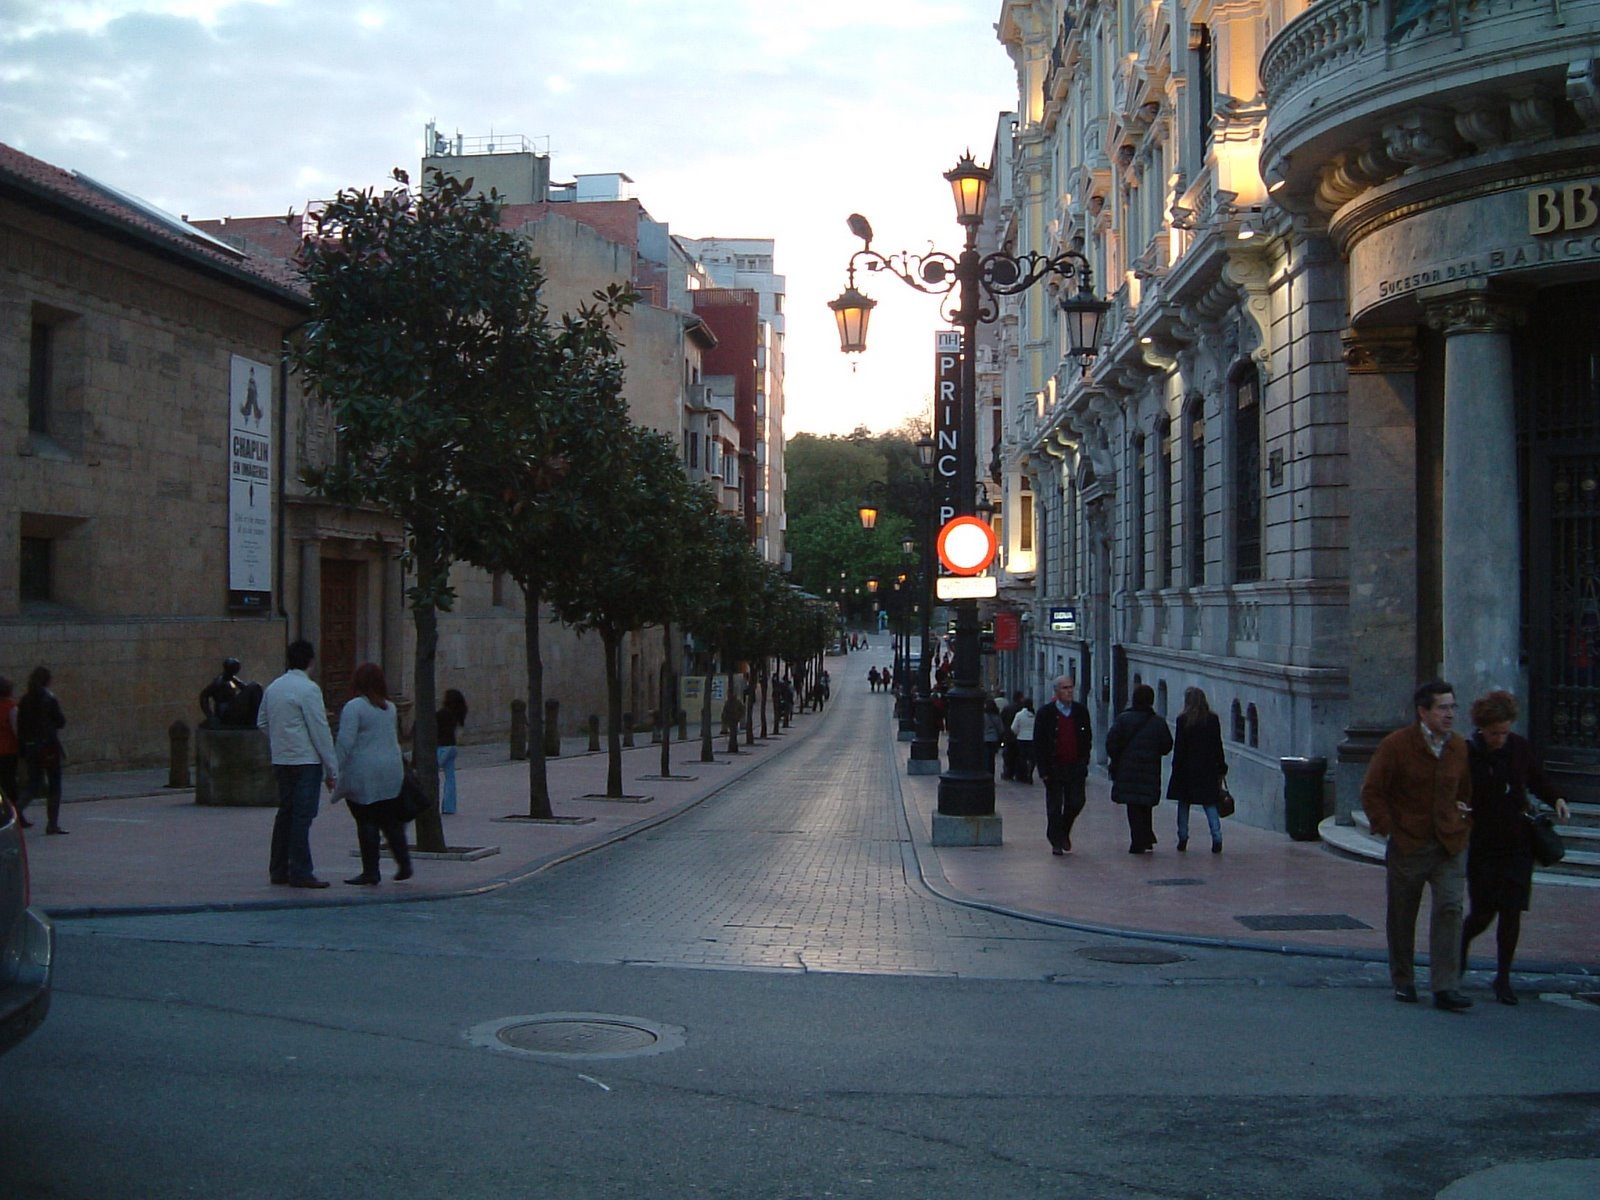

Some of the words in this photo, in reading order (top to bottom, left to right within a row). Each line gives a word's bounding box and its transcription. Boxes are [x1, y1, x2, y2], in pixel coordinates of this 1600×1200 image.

[1528, 182, 1600, 236] BB
[1447, 261, 1481, 277] DEL
[233, 435, 269, 462] CHAPLIN
